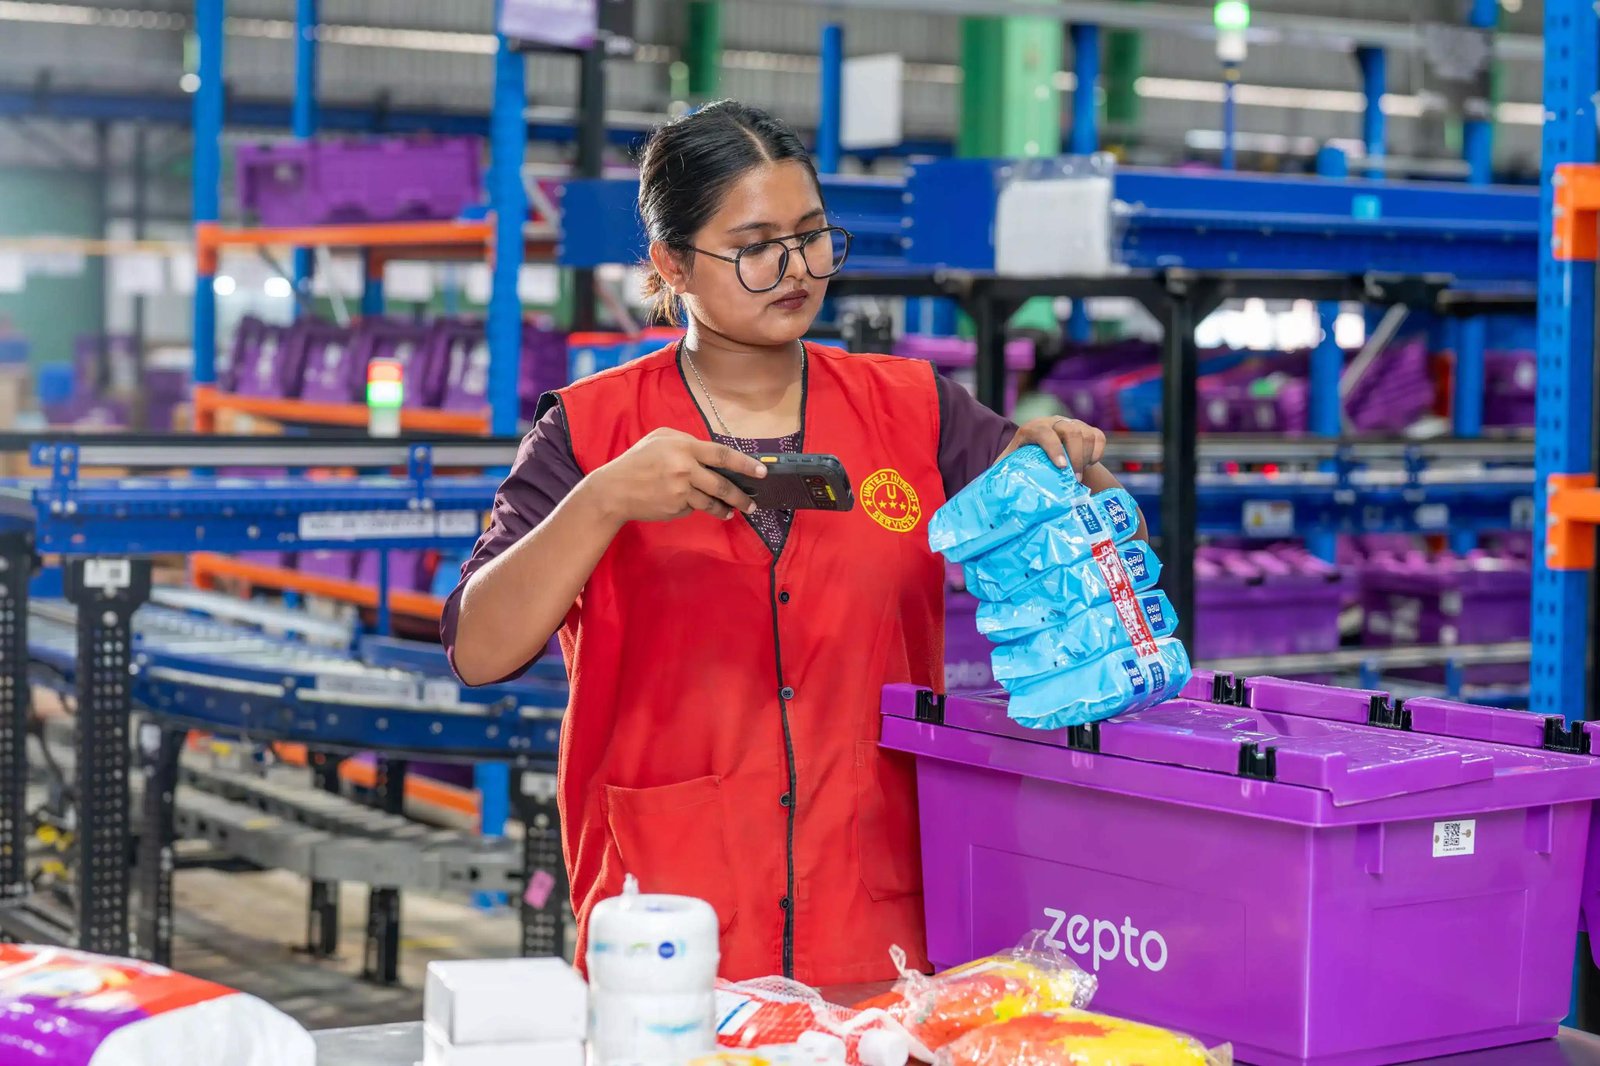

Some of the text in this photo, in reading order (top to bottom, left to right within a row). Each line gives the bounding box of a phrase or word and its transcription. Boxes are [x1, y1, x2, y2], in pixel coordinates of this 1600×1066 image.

[863, 472, 888, 498] UNITED
[890, 472, 917, 502] HITECH
[886, 484, 897, 500] U
[872, 510, 916, 530] SERVICES
[1128, 553, 1144, 565] mee
[1146, 603, 1160, 614] mee
[1150, 613, 1163, 624] mee
[1043, 907, 1168, 972] zepto
